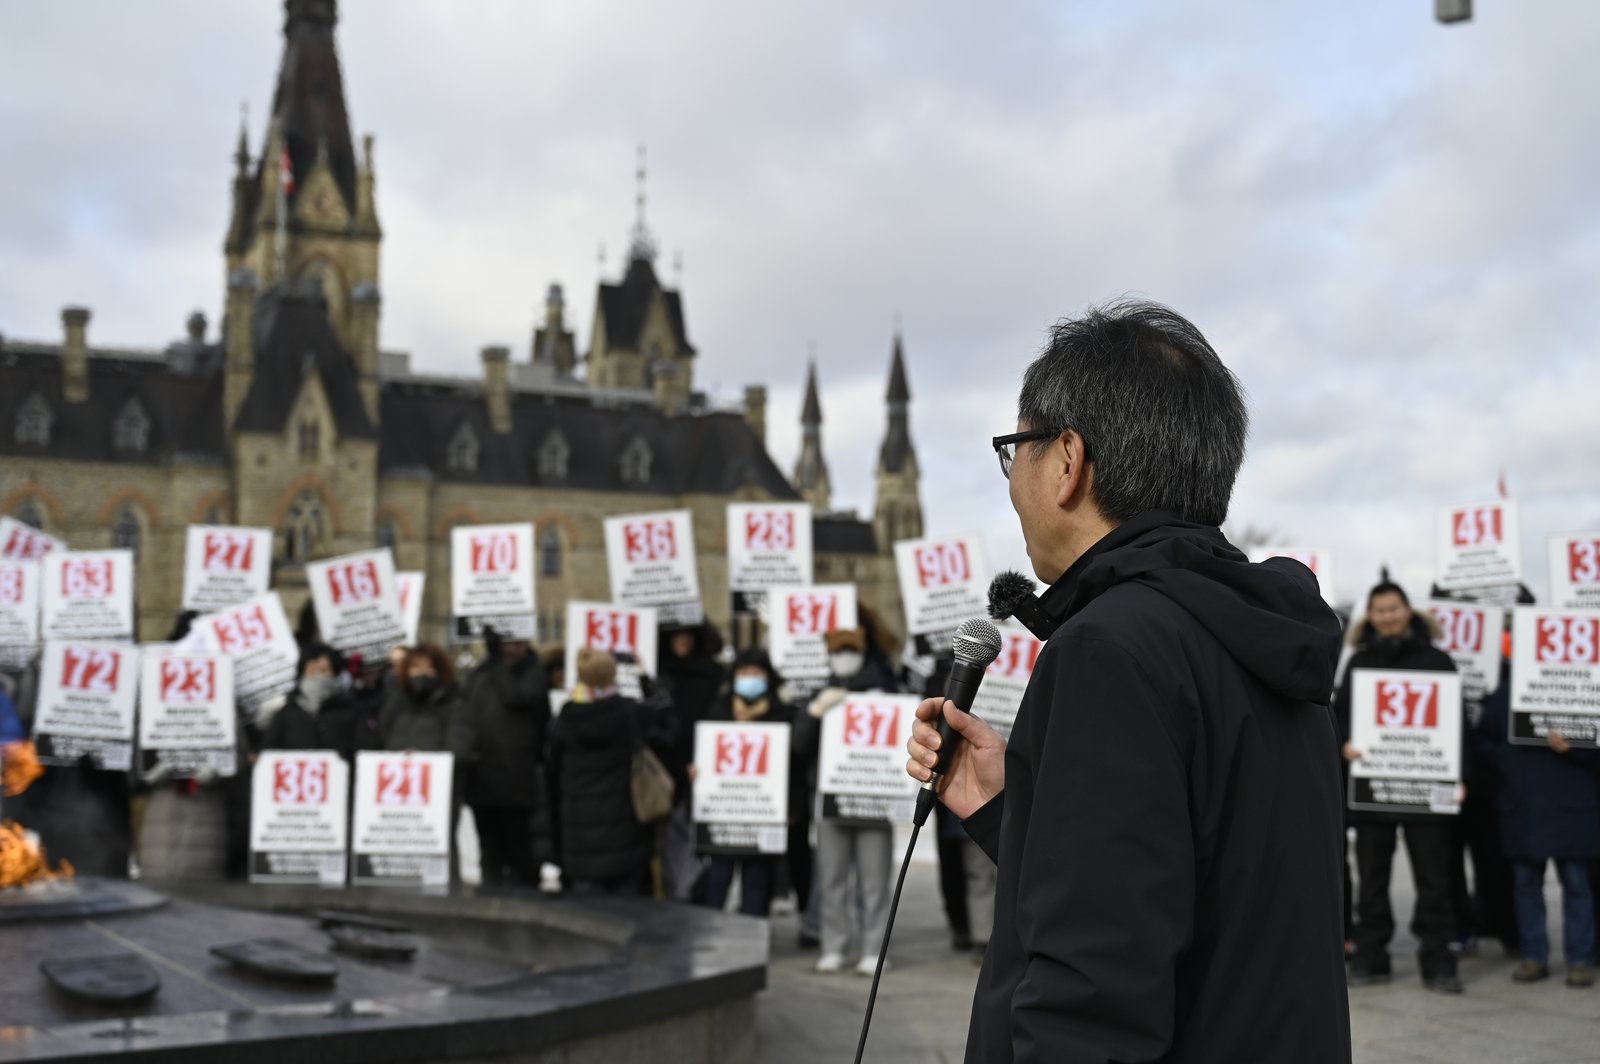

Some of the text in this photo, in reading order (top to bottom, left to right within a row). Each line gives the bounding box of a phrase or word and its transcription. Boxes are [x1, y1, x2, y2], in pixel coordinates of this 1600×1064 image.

[627, 521, 673, 559] 36
[748, 513, 792, 548] 28
[1455, 508, 1500, 546] 41
[207, 534, 251, 570] 27
[473, 535, 514, 573] 70
[918, 544, 968, 586] 90
[1571, 540, 1600, 582] 3
[65, 561, 110, 595] 63
[330, 561, 378, 603] 16
[216, 608, 269, 650] 35
[589, 611, 635, 651] 31
[790, 595, 835, 633] 37
[1435, 609, 1481, 651] 30
[1539, 617, 1600, 664] 38
[65, 651, 117, 690] 72
[163, 661, 213, 700] 23
[1378, 680, 1437, 728] 37
[846, 705, 897, 747] 37
[717, 733, 766, 775] 37
[276, 761, 325, 803] 36
[379, 762, 429, 804] 21
